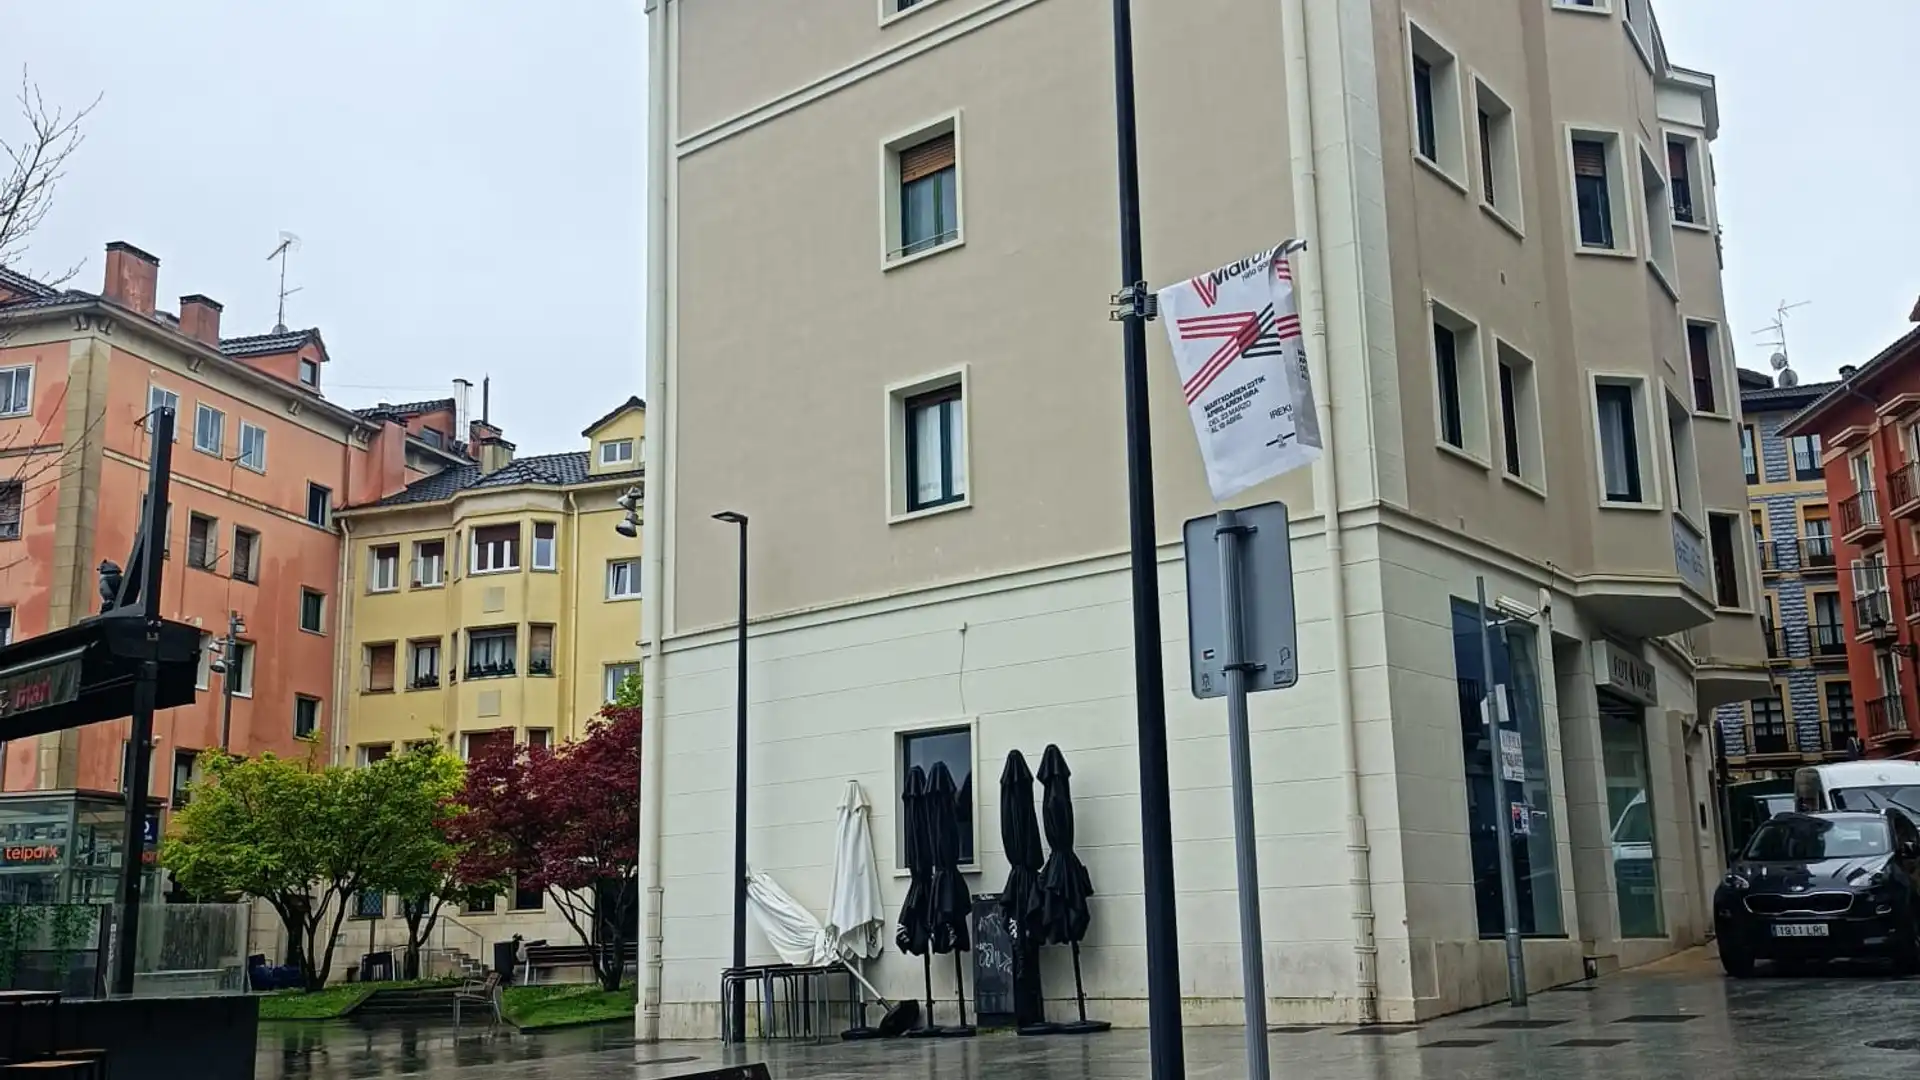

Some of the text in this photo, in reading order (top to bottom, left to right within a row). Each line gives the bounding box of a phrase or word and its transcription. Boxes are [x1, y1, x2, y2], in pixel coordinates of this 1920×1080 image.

[1208, 417, 1220, 427] DEL
[1228, 400, 1252, 416] MARZO
[1210, 425, 1219, 434] AL
[1225, 413, 1243, 426] ABRIL
[6, 844, 57, 862] telpark
